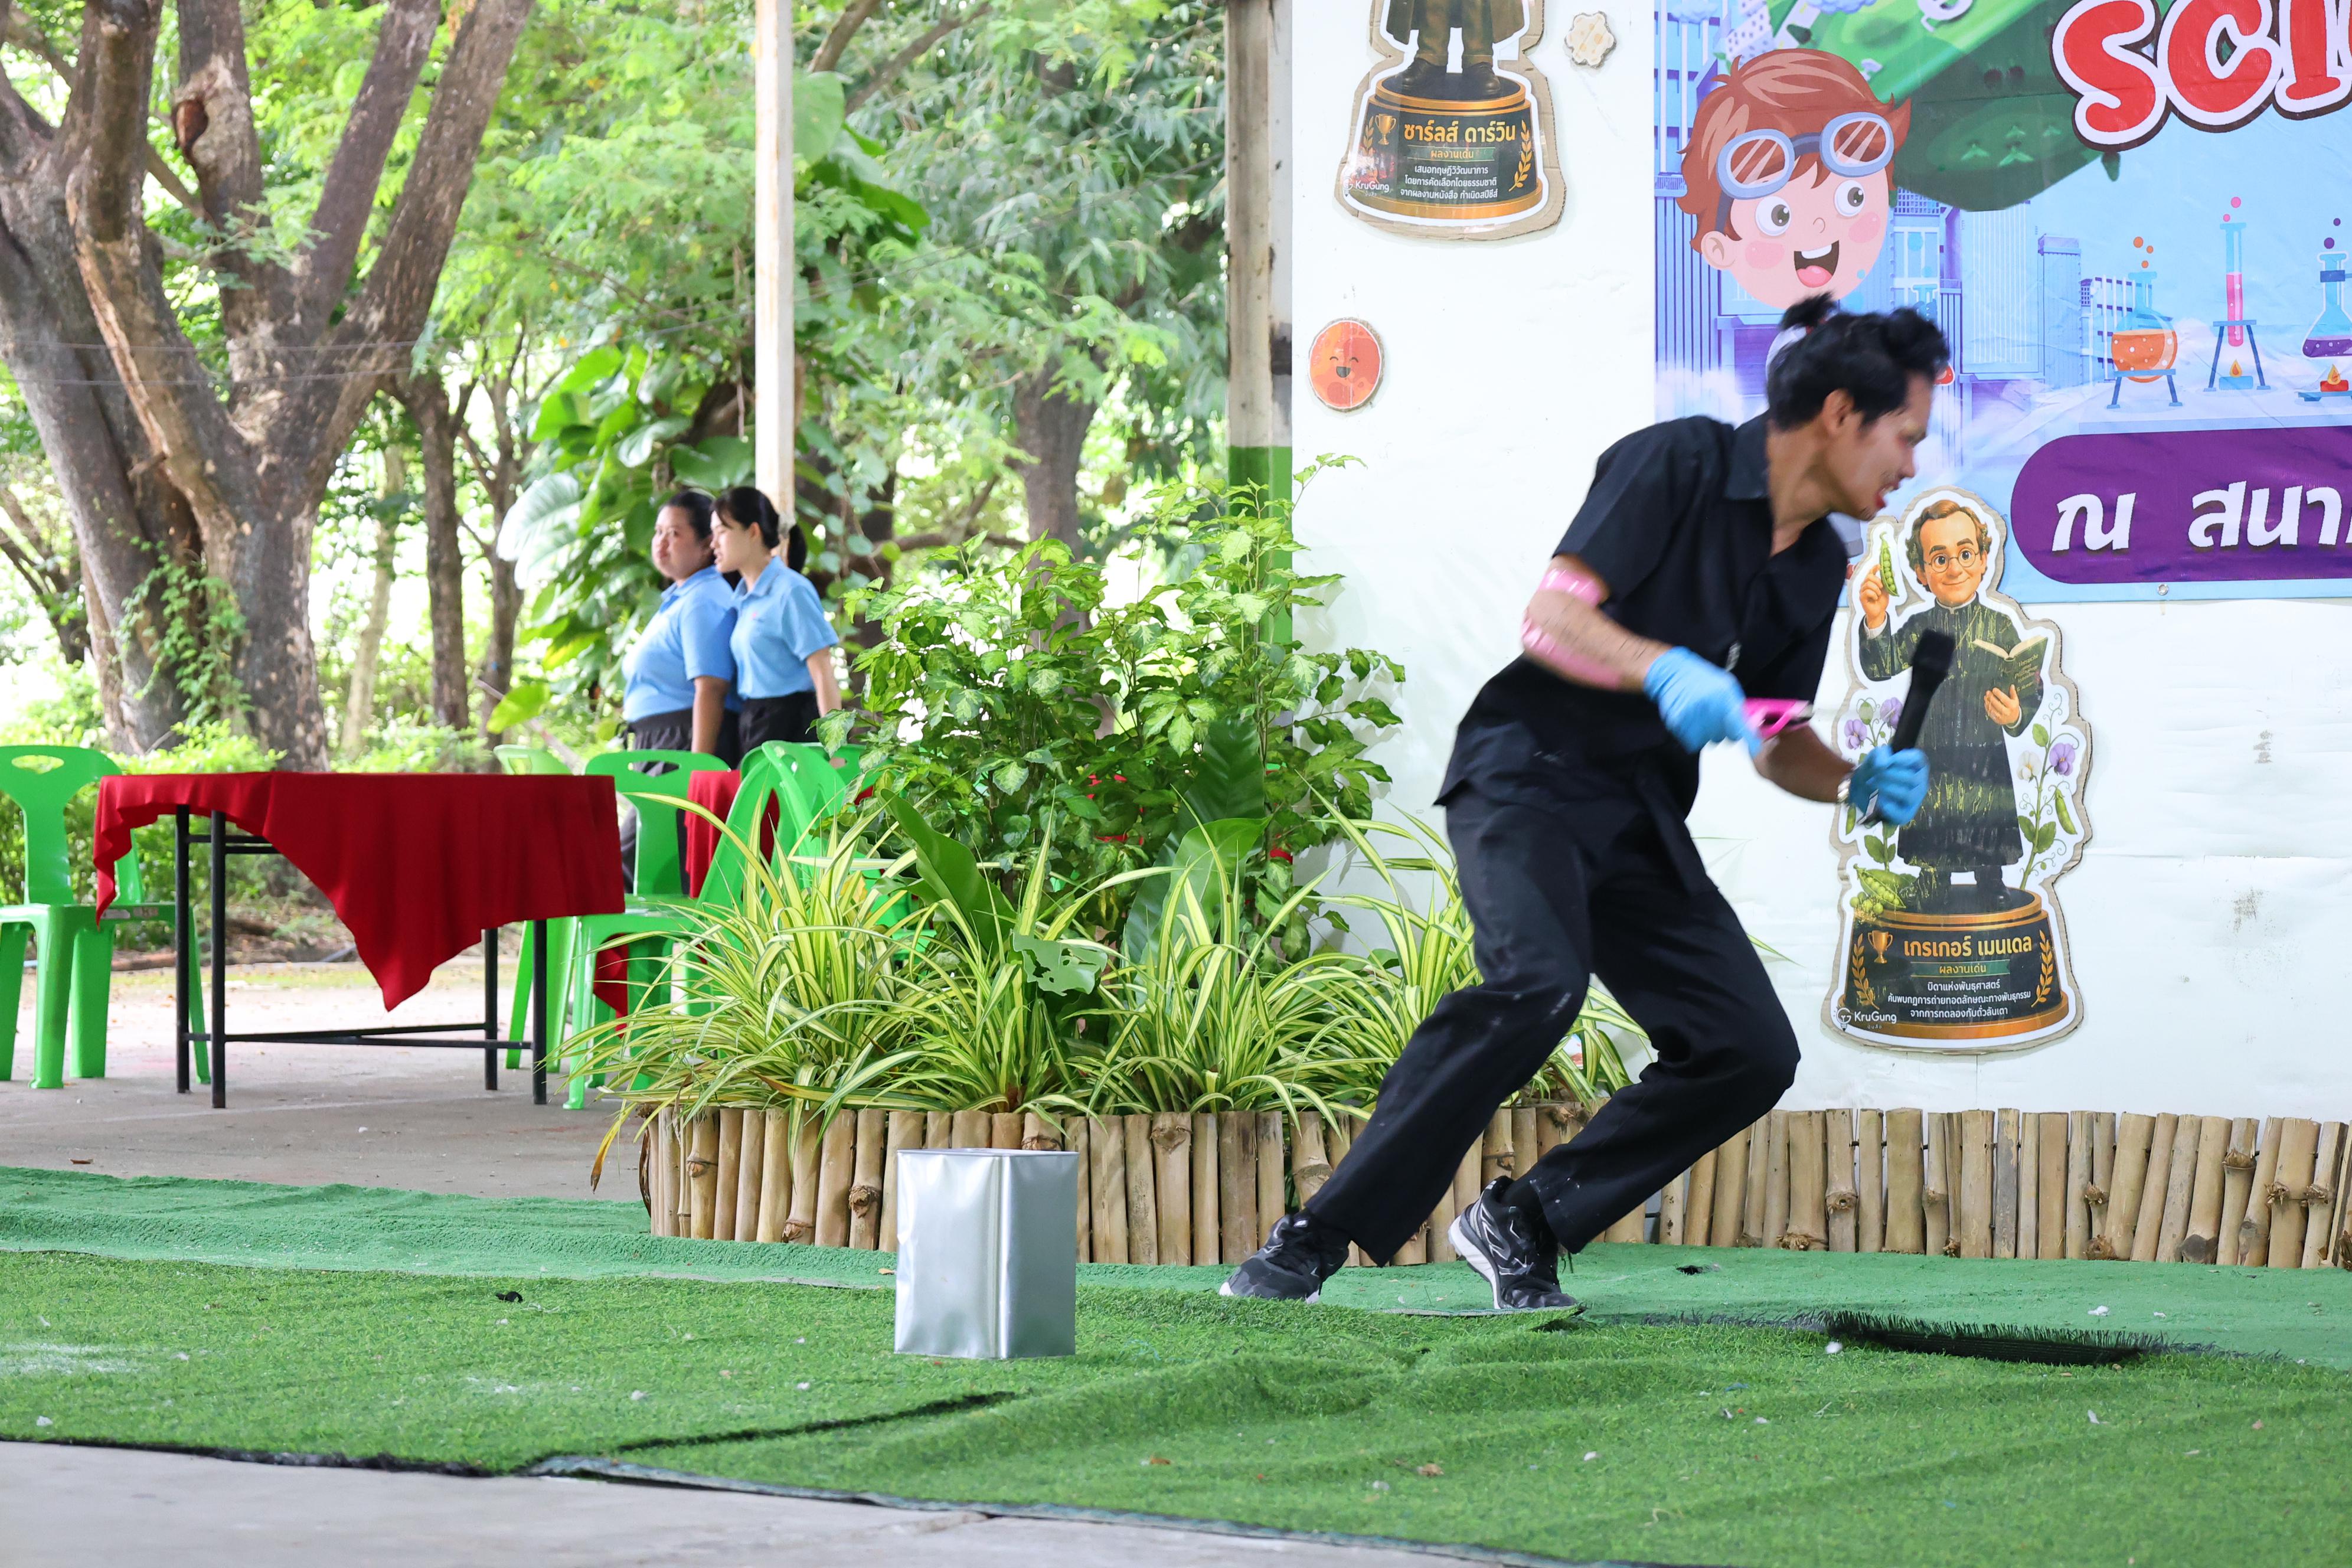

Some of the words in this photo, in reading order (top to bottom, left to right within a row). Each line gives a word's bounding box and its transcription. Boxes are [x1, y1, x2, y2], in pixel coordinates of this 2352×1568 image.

[2051, 0, 2352, 146] SCI
[1465, 120, 1515, 142] ดาร์วิน
[1355, 180, 1390, 193] KruGung
[2052, 492, 2137, 553] ณ
[2188, 480, 2352, 550] สนา
[1904, 935, 1972, 957] เกรเกอร์
[1978, 936, 2032, 956] เมนเดล
[1939, 962, 1987, 974] ผลงานเด่น
[1928, 979, 2001, 993] บิดาแห่งพันธุศาสตร์
[1854, 1011, 1897, 1024] KruGung
[1910, 1005, 2008, 1018] จากการทดลองกับถั่วลันเตา
